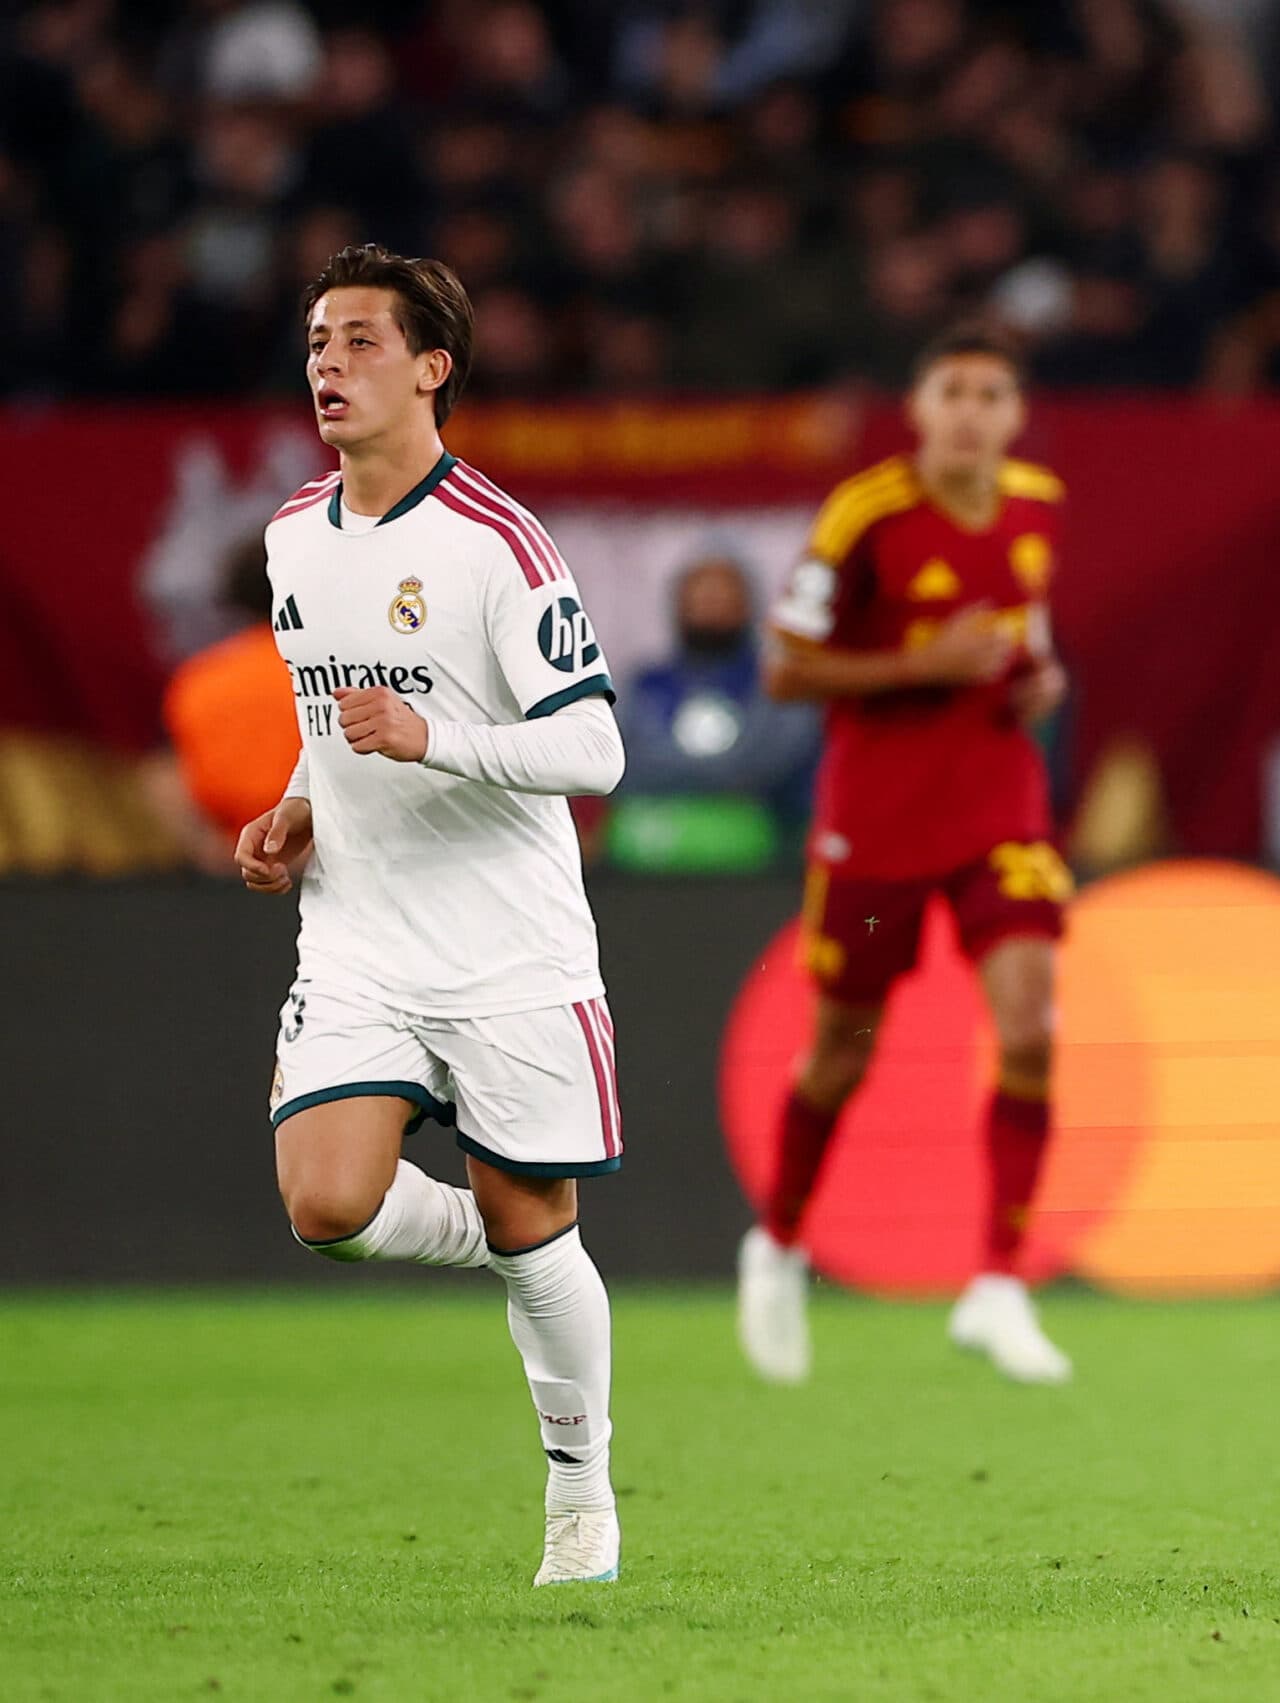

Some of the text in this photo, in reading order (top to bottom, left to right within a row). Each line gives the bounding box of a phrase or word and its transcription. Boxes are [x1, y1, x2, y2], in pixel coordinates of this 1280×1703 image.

[549, 599, 597, 673] hp
[285, 654, 434, 697] mirates
[306, 703, 333, 737] FLY
